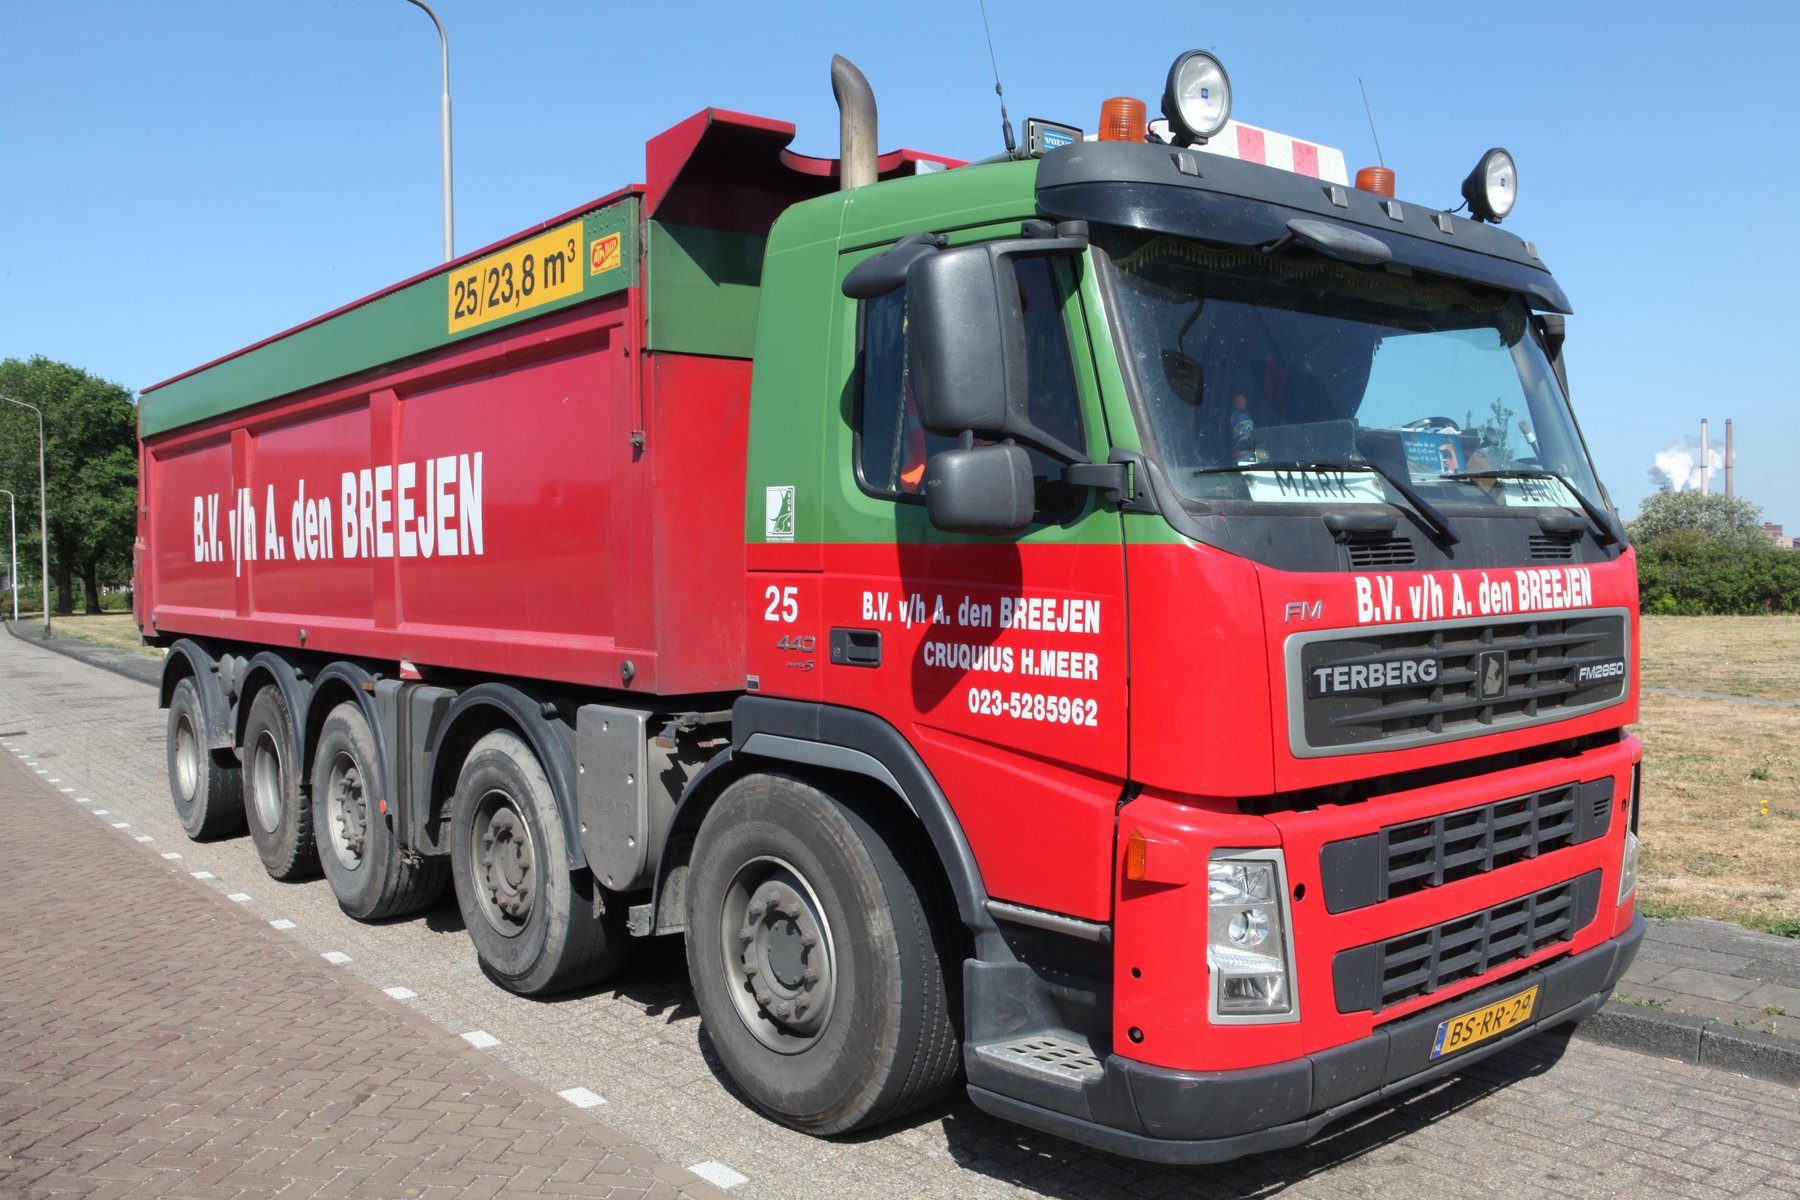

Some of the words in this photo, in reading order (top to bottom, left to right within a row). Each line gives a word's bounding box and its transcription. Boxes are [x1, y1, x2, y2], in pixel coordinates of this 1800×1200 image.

[454, 254, 535, 320] 25/23,8
[1273, 471, 1356, 498] MARK
[193, 493, 224, 562] B.V.
[228, 487, 257, 577] v/h
[264, 484, 286, 561] A.
[291, 479, 334, 561] den
[341, 451, 484, 559] BREEJEN
[763, 585, 799, 623] 25
[862, 591, 892, 622] B.V.
[898, 593, 926, 629] v/h
[933, 594, 951, 625] A.
[958, 595, 992, 628] den
[999, 597, 1100, 634] BREEJEN
[1284, 600, 1323, 623] FM
[1354, 575, 1401, 624] B.V.
[1408, 573, 1444, 621] v/h
[1452, 573, 1472, 616] A.
[1478, 572, 1512, 615] den
[1514, 567, 1593, 611] BREEJEN
[775, 634, 816, 653] 440
[923, 641, 1014, 674] CRUQUIUS
[1020, 648, 1099, 681] H.MEER
[1313, 658, 1438, 694] TERBERG
[968, 687, 1098, 727] 023-5285962
[1450, 994, 1531, 1047] BS-RR-29
